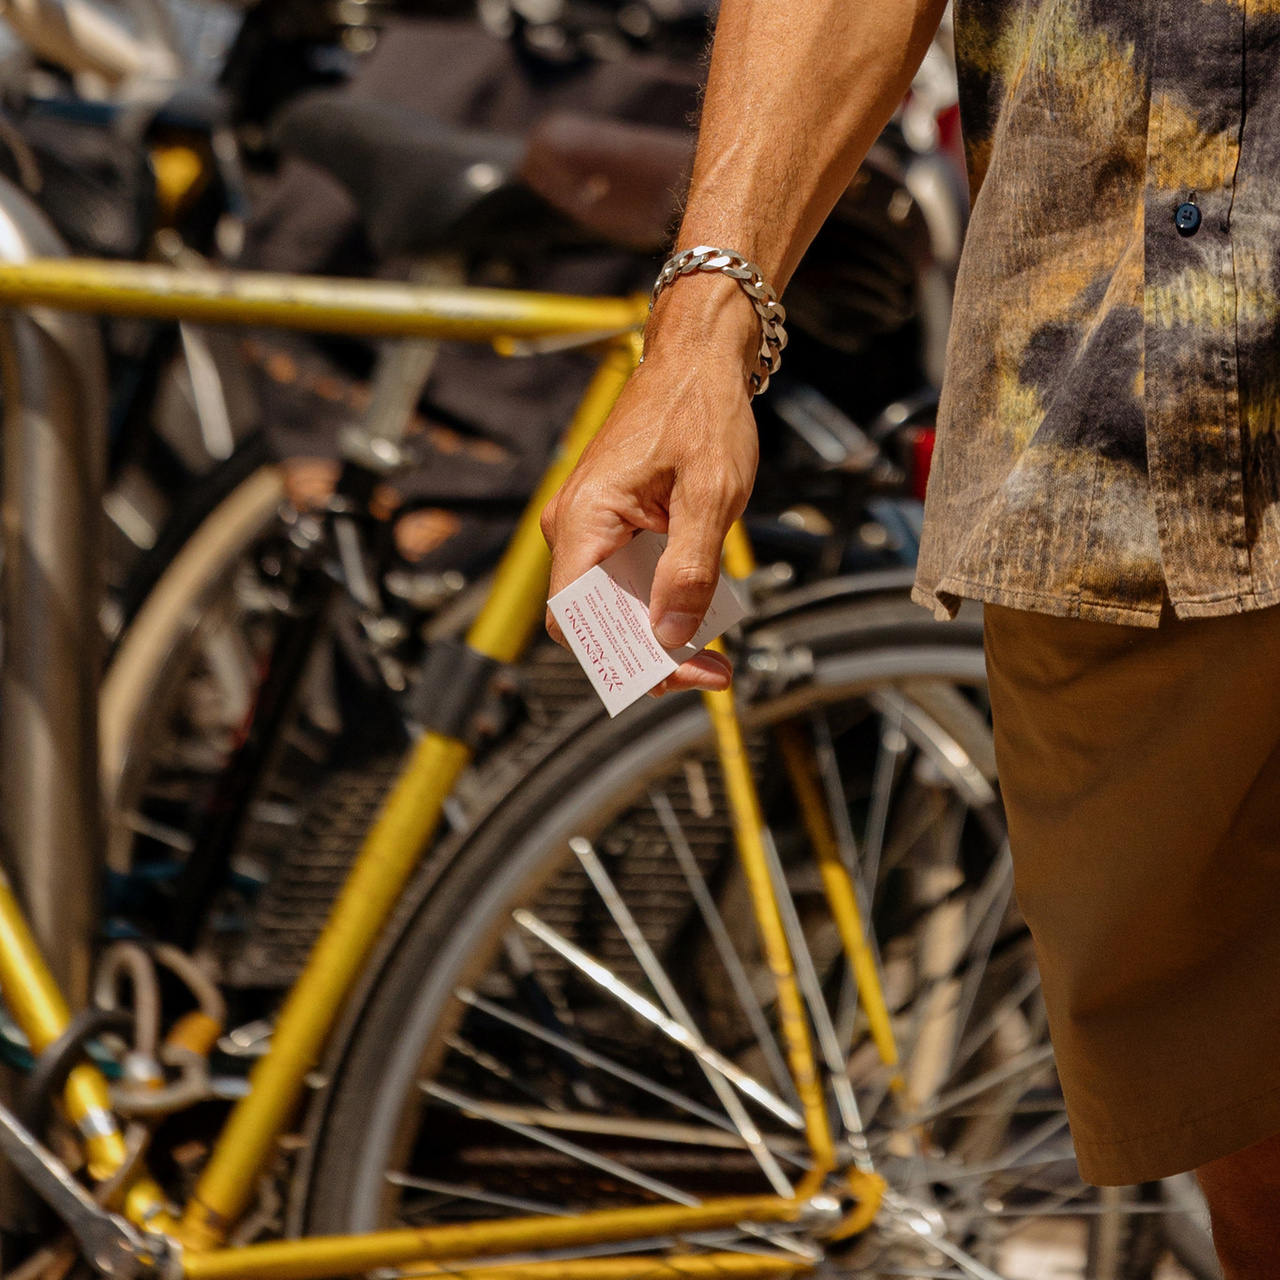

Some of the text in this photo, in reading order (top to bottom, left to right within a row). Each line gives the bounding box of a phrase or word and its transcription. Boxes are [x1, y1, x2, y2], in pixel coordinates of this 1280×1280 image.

[584, 595, 599, 620] SHOW
[564, 607, 614, 692] VALENTINO
[572, 600, 623, 691] The Narratives
[598, 620, 619, 654] FASHION
[614, 624, 629, 645] JUNE
[626, 644, 645, 673] FRIDAY
